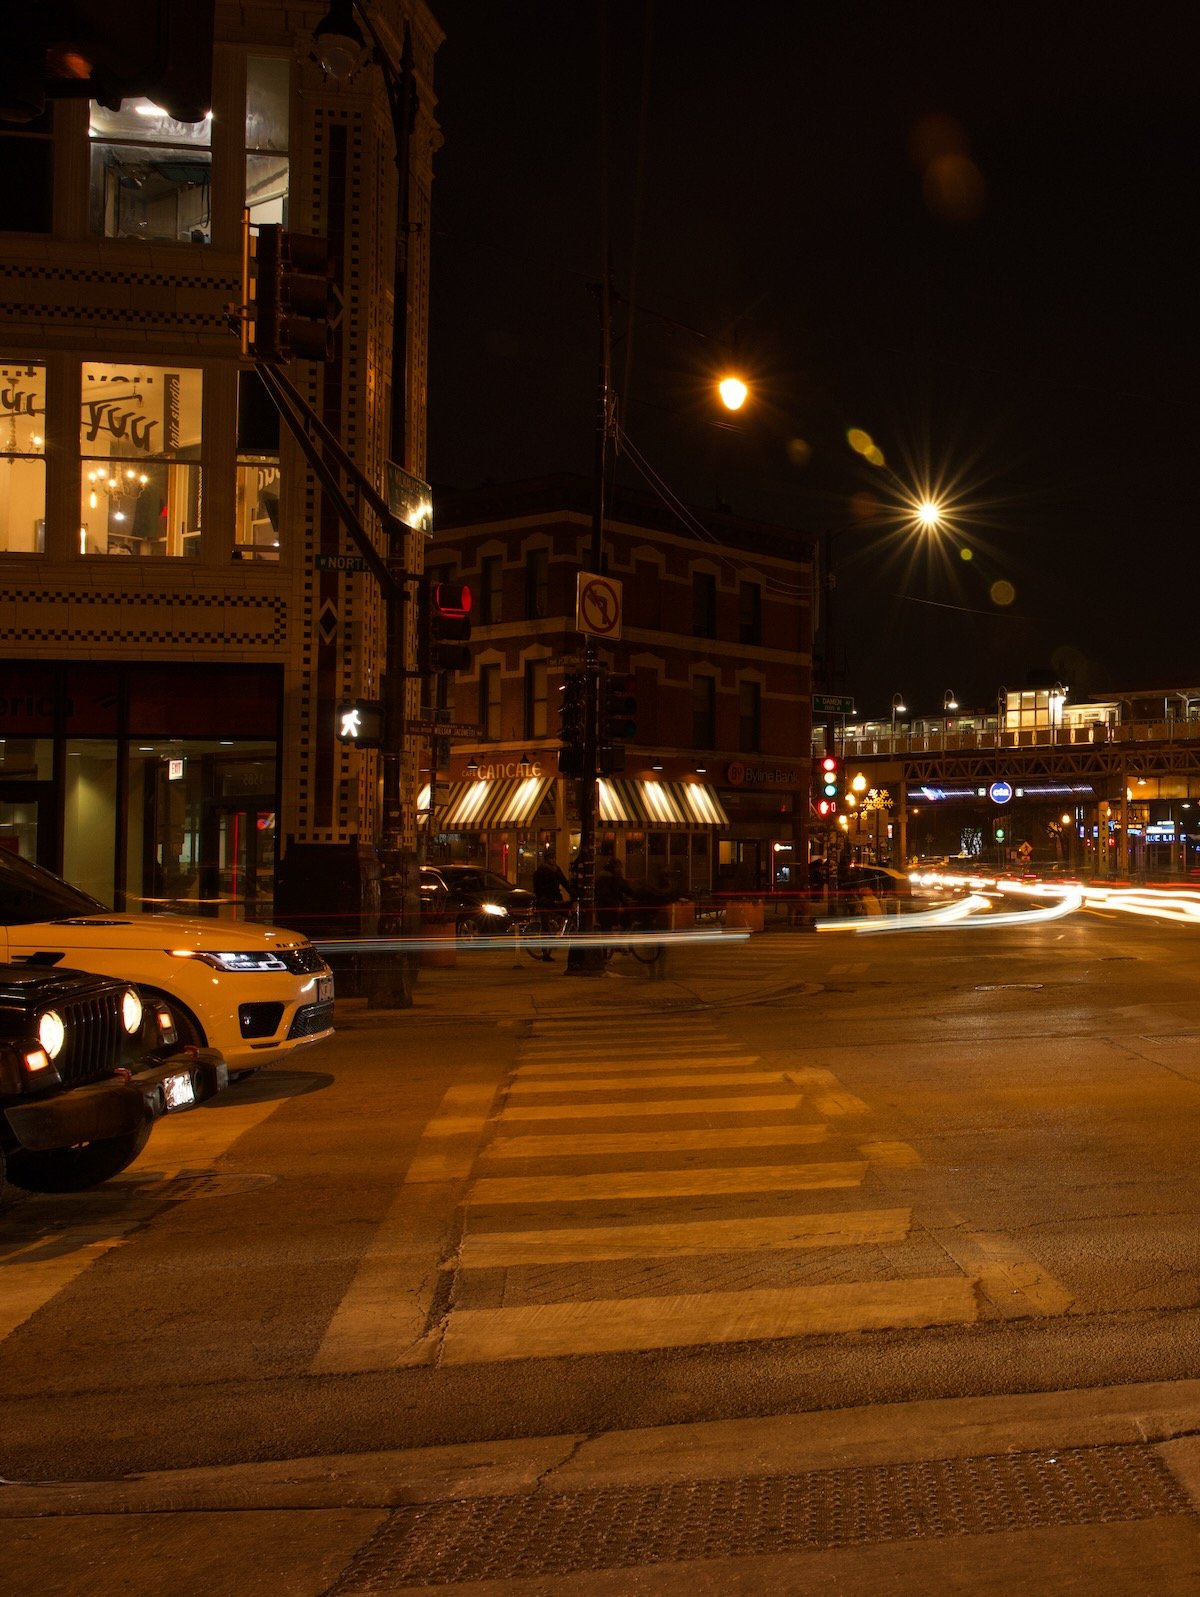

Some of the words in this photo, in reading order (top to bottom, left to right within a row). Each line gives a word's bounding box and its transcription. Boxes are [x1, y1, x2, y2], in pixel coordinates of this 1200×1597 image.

[169, 378, 180, 421] studio
[169, 420, 180, 450] hair
[328, 557, 369, 570] NORTH
[477, 762, 542, 780] CANCALE
[746, 767, 775, 784] Byline
[776, 769, 799, 783] Bank
